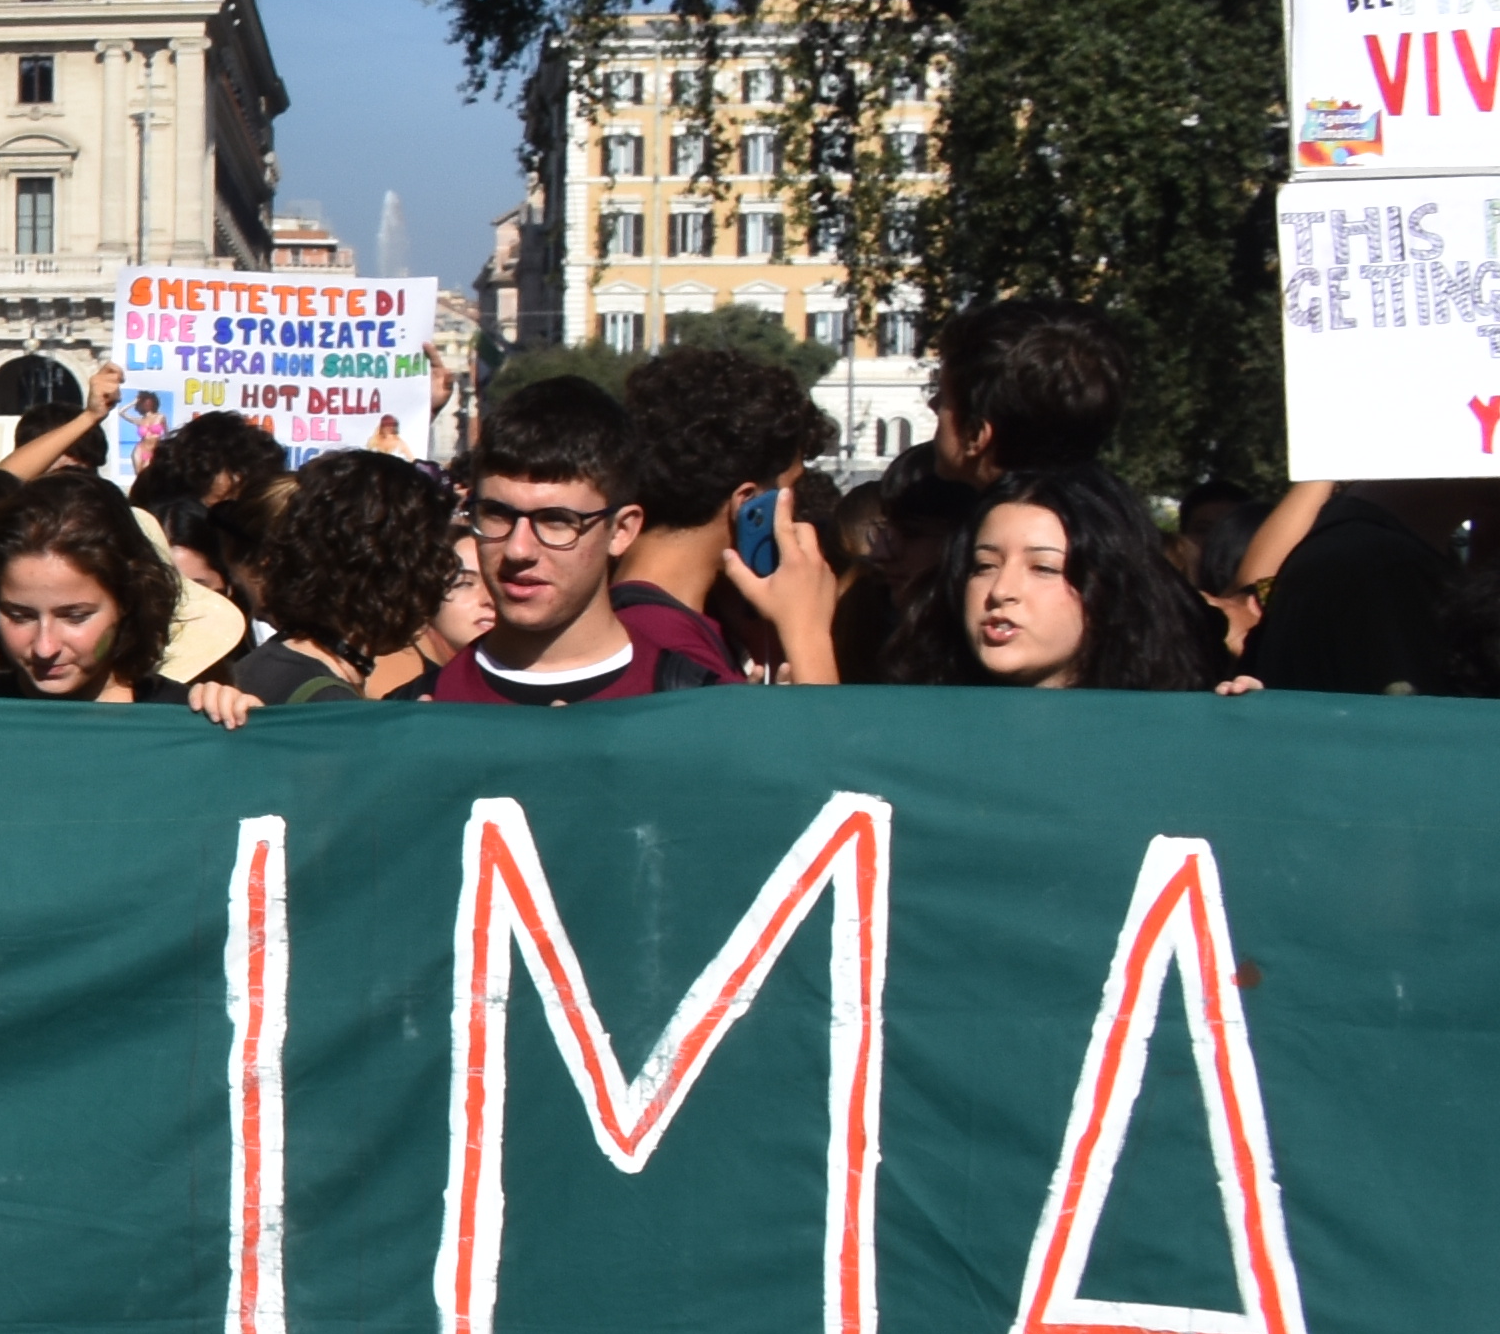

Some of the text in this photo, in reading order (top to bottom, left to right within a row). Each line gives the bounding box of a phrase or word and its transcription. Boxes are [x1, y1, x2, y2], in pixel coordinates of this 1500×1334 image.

[1280, 202, 1445, 266] THIS
[128, 276, 405, 317] SMETTETETE DI
[1284, 260, 1500, 334] GETTING
[125, 310, 197, 343] DIRE
[126, 342, 163, 372] LA
[174, 345, 265, 375] TERRA
[272, 351, 315, 377] NON
[241, 383, 300, 411] HOT
[307, 386, 382, 415] DELLA
[292, 415, 342, 442] DEL
